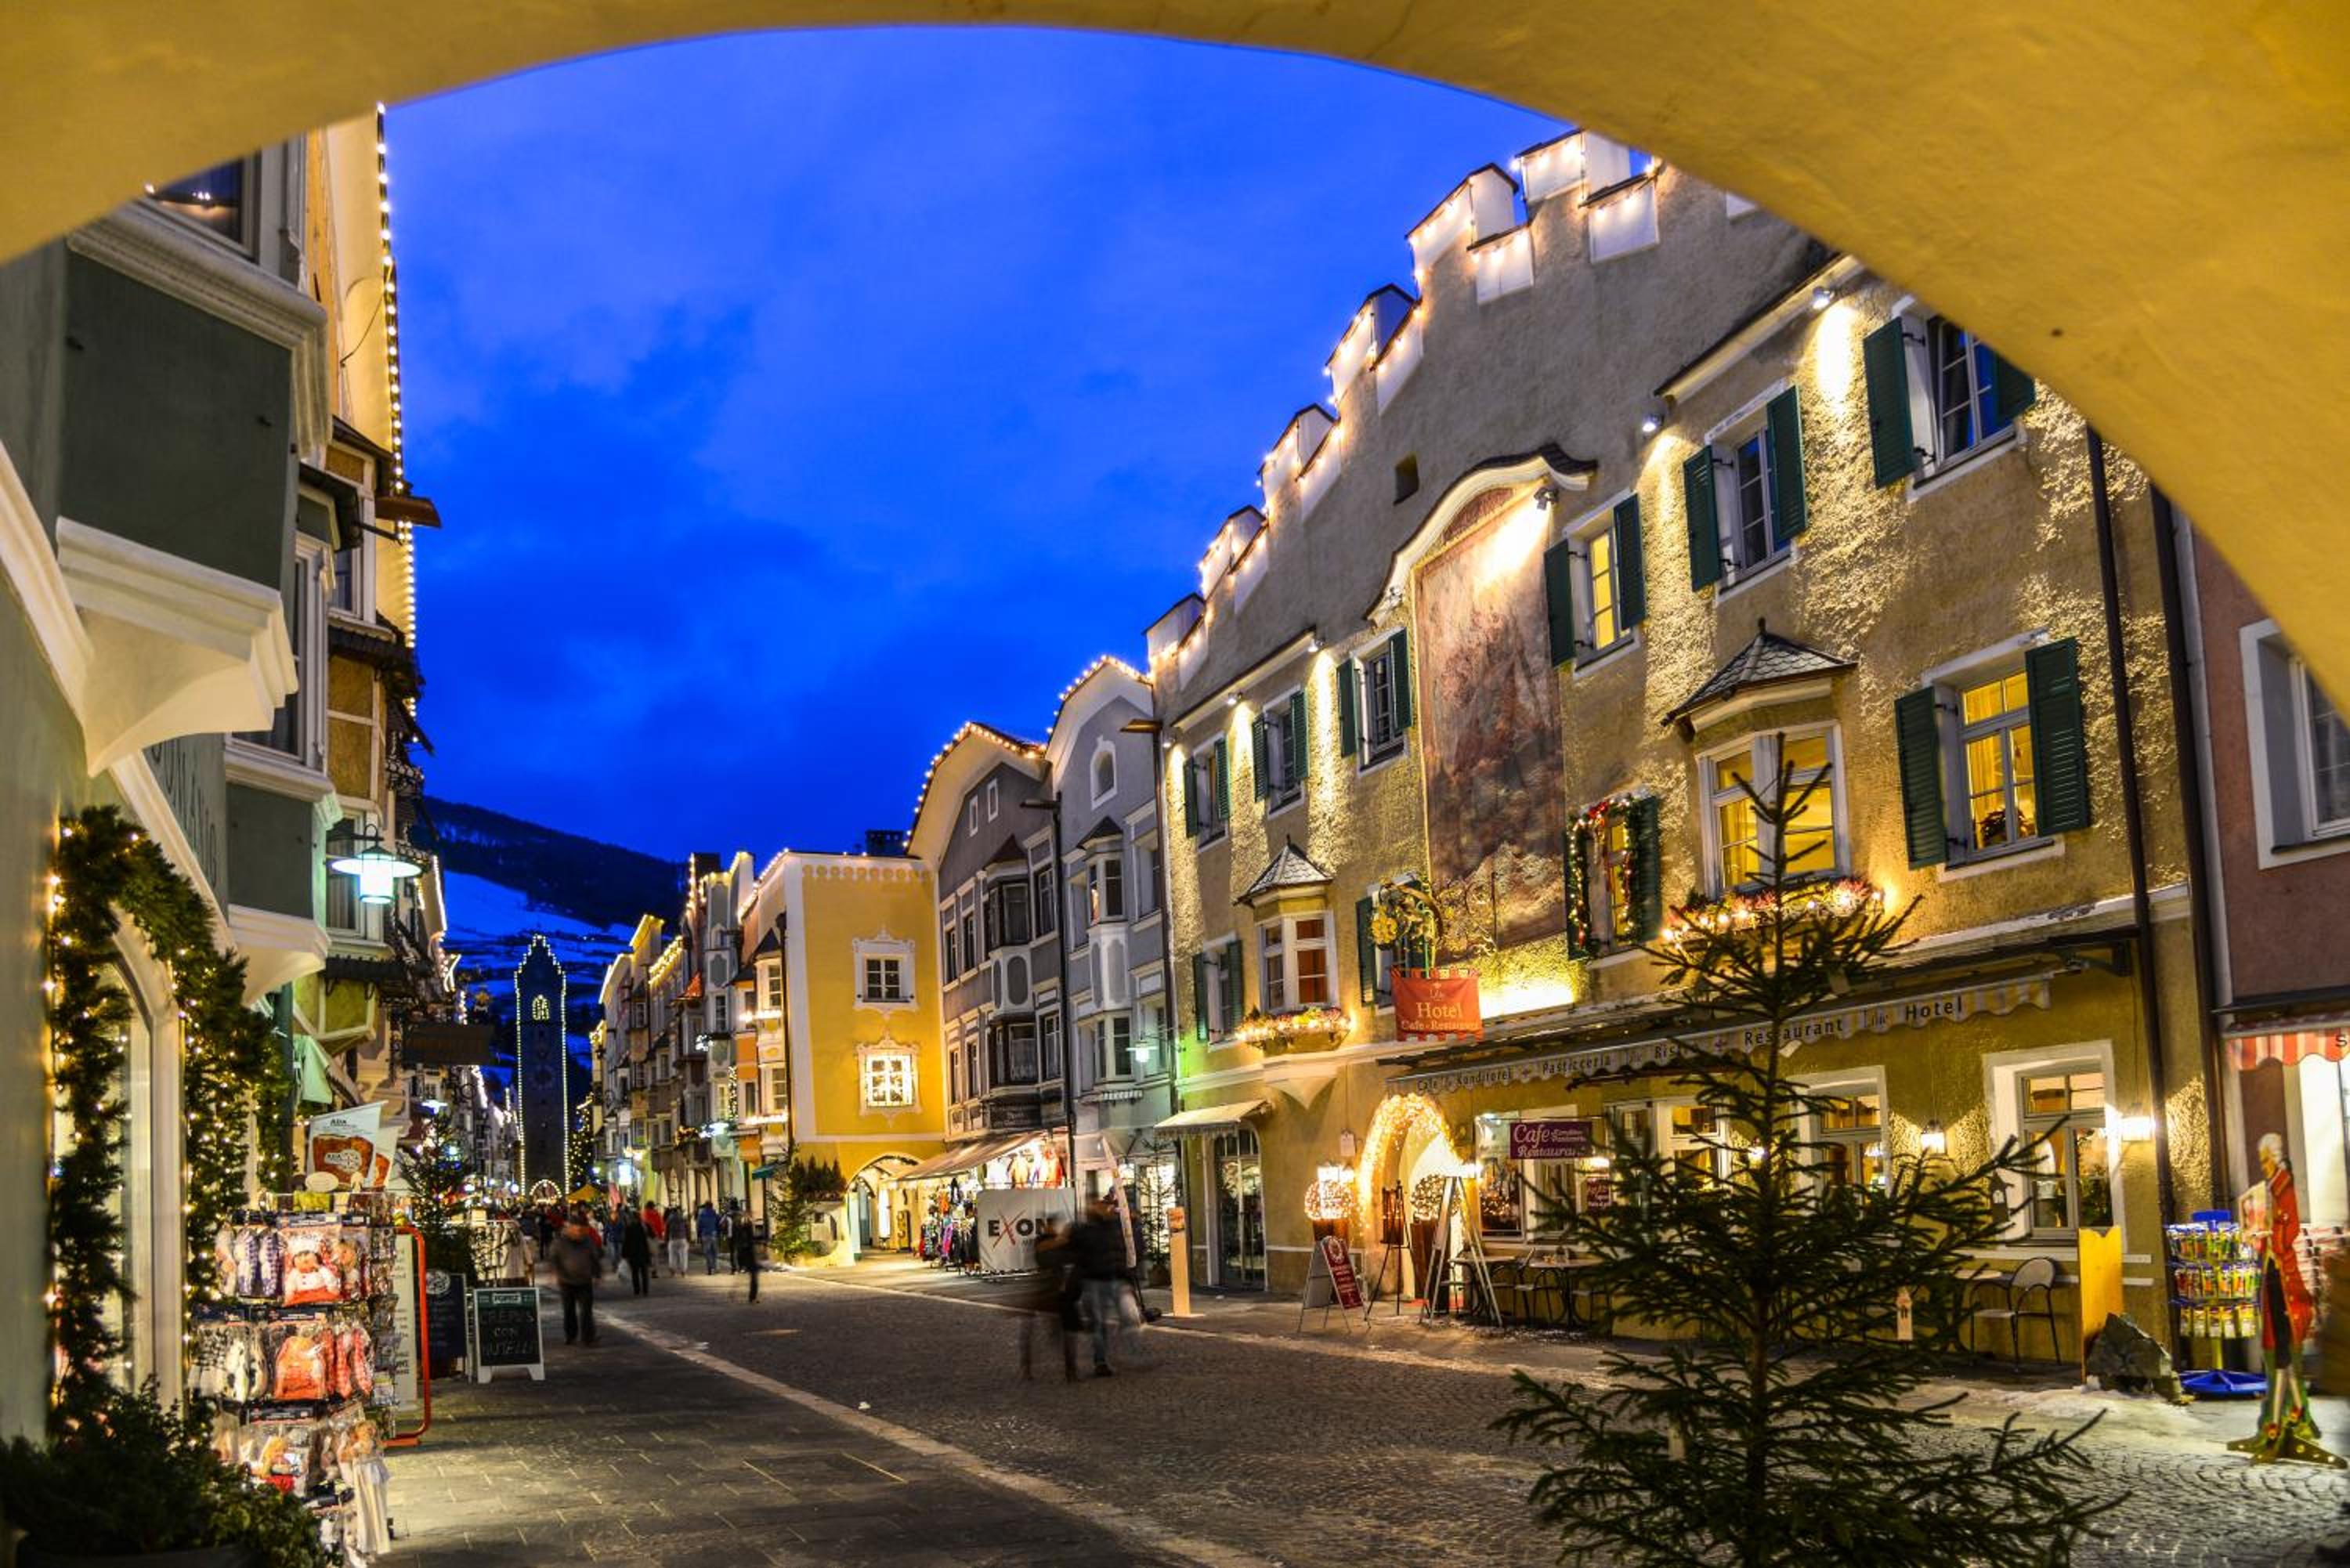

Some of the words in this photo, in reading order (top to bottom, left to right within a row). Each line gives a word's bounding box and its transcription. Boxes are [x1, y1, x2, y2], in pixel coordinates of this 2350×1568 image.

[1415, 1002, 1462, 1019] Hotel
[1542, 1054, 1611, 1075] Pasticceria
[1744, 1018, 1843, 1046] Resaurant
[1904, 996, 1962, 1020] Hotel
